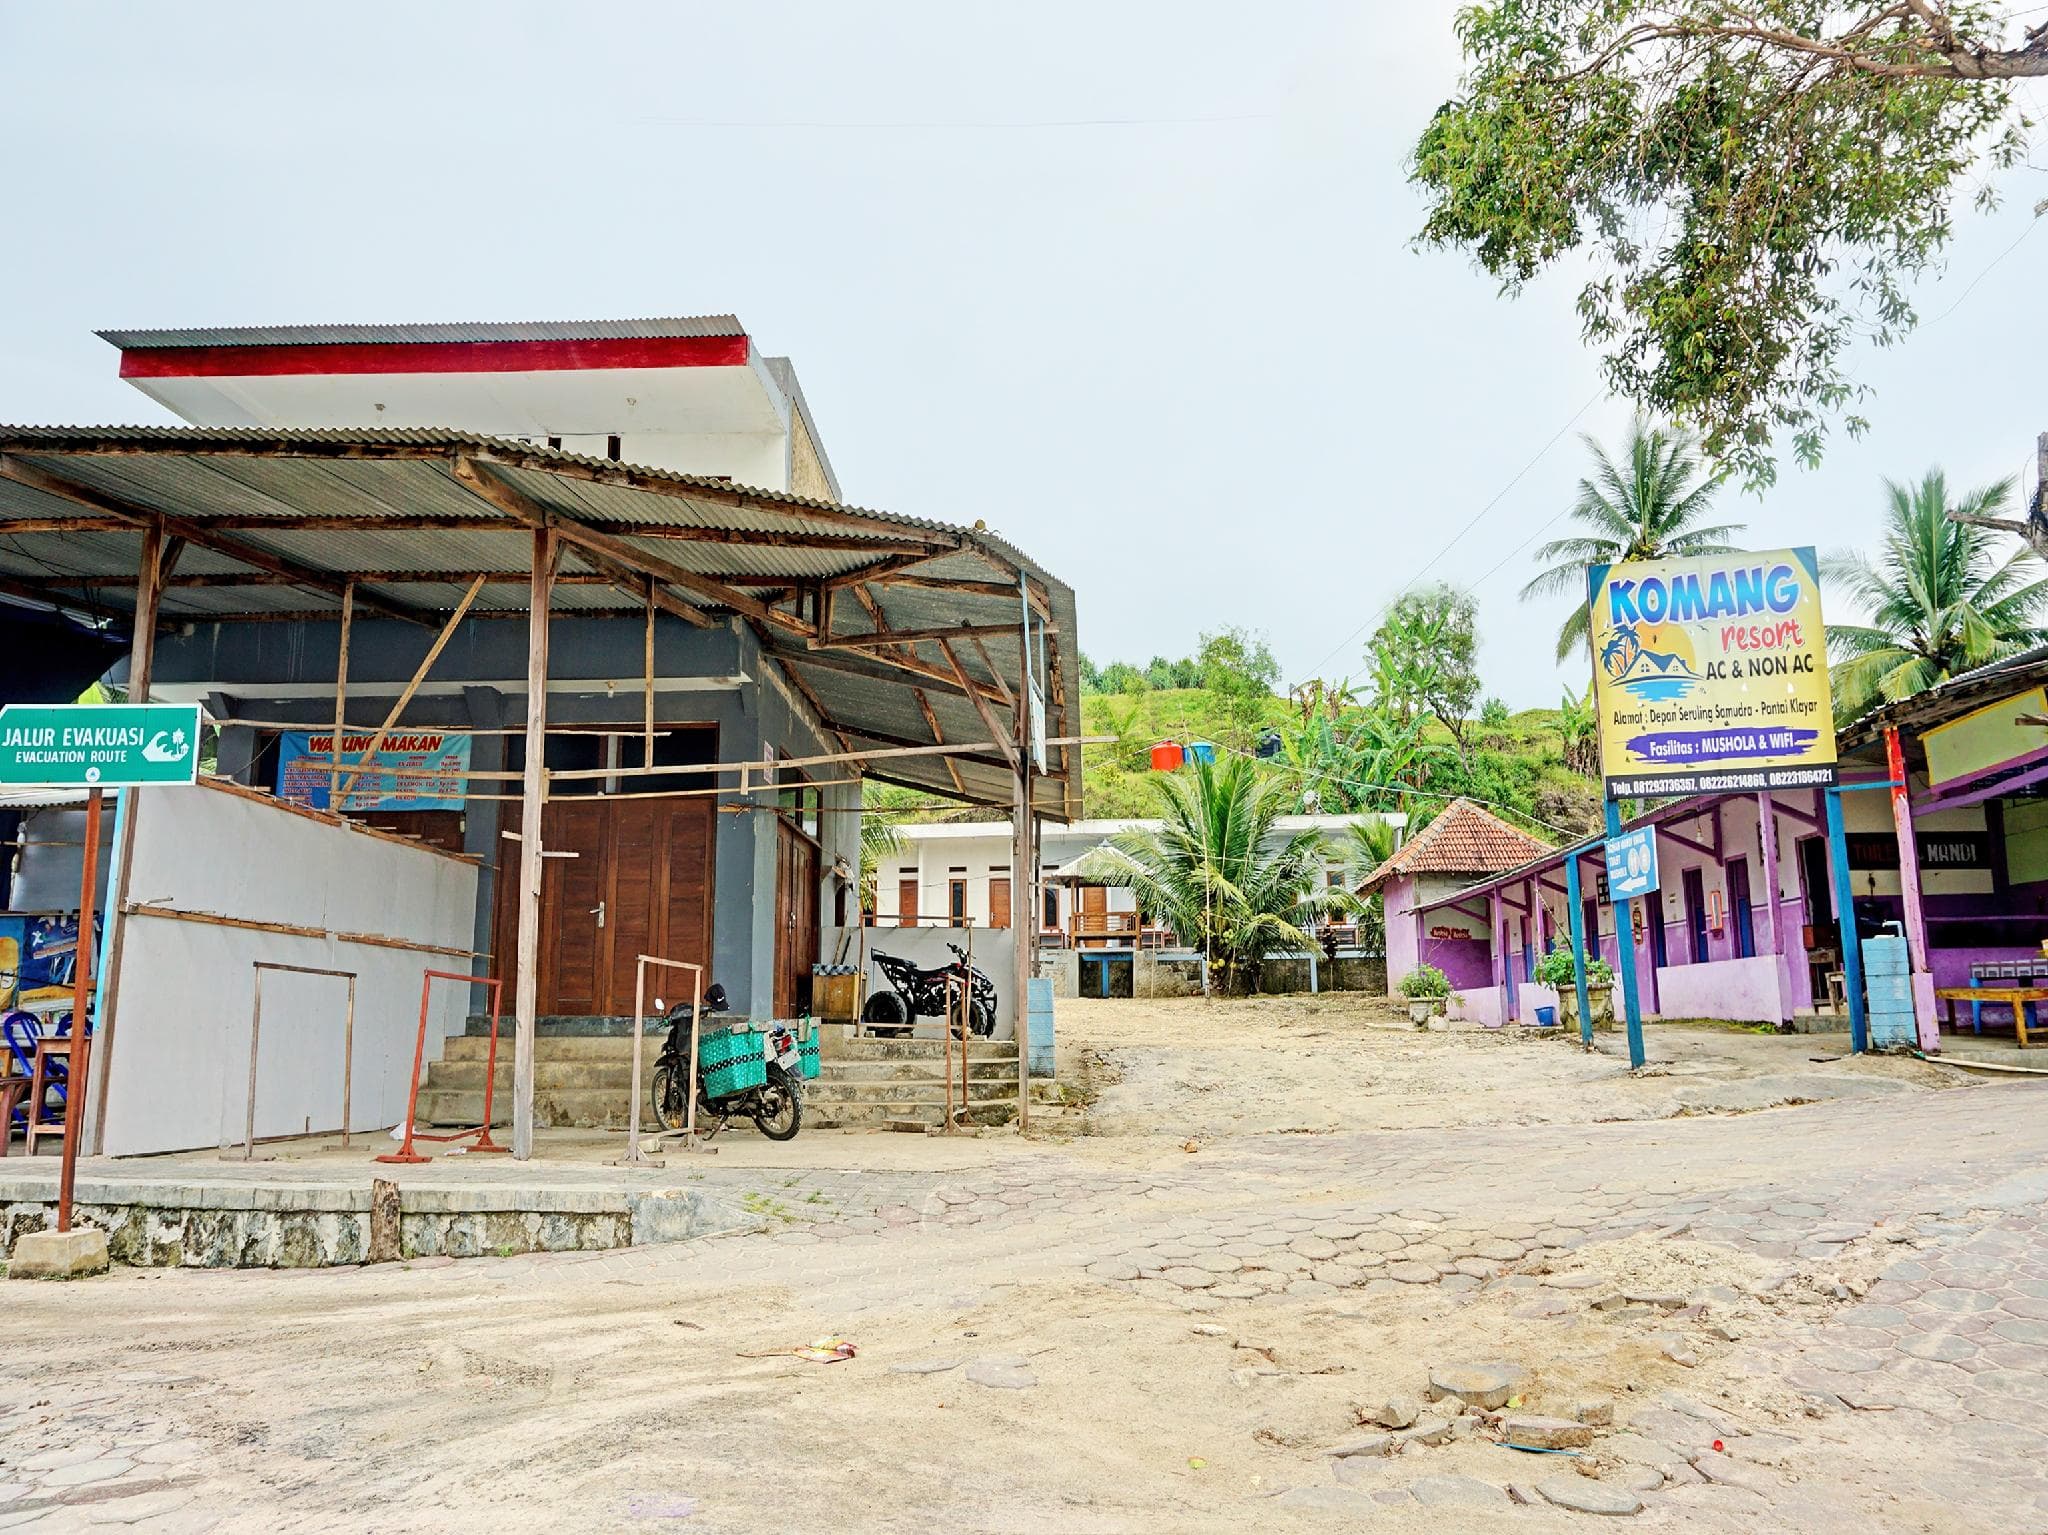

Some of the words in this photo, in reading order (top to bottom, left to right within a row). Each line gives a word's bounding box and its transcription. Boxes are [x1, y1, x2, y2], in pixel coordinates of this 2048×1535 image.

[1608, 565, 1800, 625] KOMANG
[1721, 619, 1804, 652] resort
[1707, 661, 1726, 680] AC
[1732, 660, 1743, 678] &
[1749, 657, 1787, 677] NON
[1792, 654, 1814, 674] AC
[1614, 711, 1643, 726] Alamat
[1650, 709, 1677, 726] Depan
[1679, 705, 1713, 723] Seruling
[1715, 703, 1753, 719] Samudra
[1761, 700, 1788, 715] Pantai
[1790, 698, 1818, 716] Klayar
[1, 727, 56, 747] JALUR
[63, 727, 144, 747] EVAKUASI
[309, 735, 375, 752] WAUN
[380, 735, 443, 752] MAKAN
[1649, 740, 1693, 757] Fasilitas
[1702, 735, 1756, 754] MUSHOLA
[1759, 734, 1767, 748] &
[1770, 732, 1794, 748] WIFI
[15, 750, 86, 763] EVACUATION
[90, 750, 127, 763] ROUTE
[1852, 843, 1896, 863] TOILE
[1927, 843, 1977, 862] MANDI
